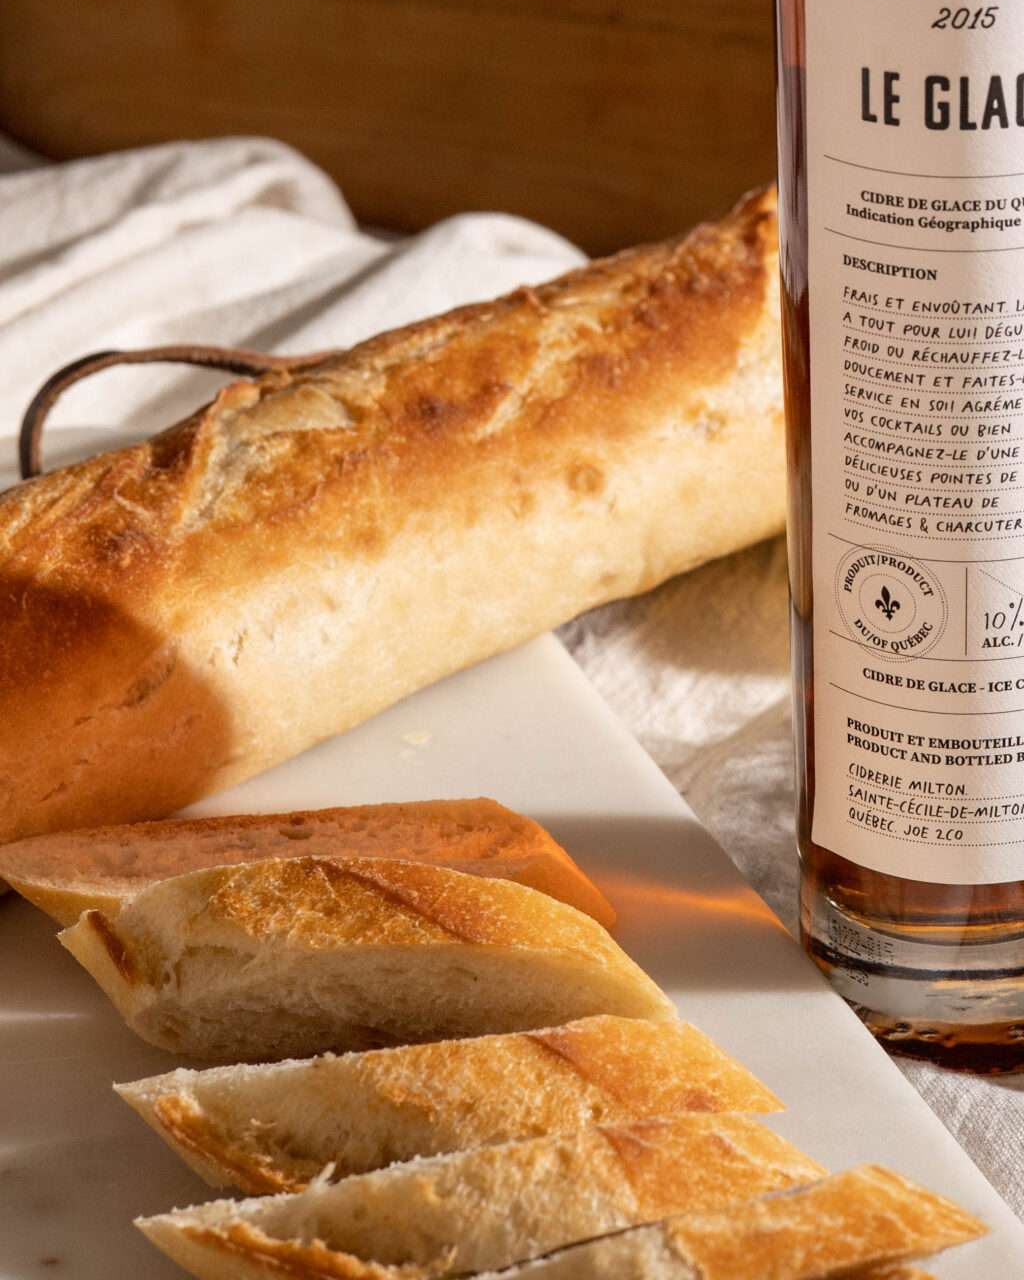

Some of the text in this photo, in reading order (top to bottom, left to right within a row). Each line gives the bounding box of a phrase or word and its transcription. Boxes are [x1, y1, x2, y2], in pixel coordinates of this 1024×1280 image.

[931, 6, 999, 29] 2015
[861, 67, 900, 127] LE
[861, 190, 904, 208] CIDRE
[908, 198, 927, 210] DE
[931, 200, 981, 212] GLACE
[986, 198, 1007, 211] DU
[846, 204, 914, 227] Indication
[918, 217, 1021, 232] Géographique
[843, 254, 938, 280] DESCRIPTION
[843, 286, 879, 306] FRAIS
[885, 297, 904, 310] ET
[842, 311, 852, 323] A
[859, 315, 896, 333] TOUT
[903, 324, 940, 339] POUR
[844, 336, 880, 353] FROID
[887, 345, 904, 359] OU
[844, 360, 926, 386] DOUCEMENT
[933, 376, 954, 387] ET
[844, 383, 894, 405] SERVICE
[901, 397, 920, 409] EN
[844, 408, 1011, 437] VOS COCKTAILS OU BIEN
[843, 432, 968, 461] ACCOMPAGNEZ-LE
[977, 446, 1020, 461] D'UNE
[845, 455, 922, 482] DÉLICIEUSES
[930, 472, 992, 485] POINTES
[1000, 471, 1018, 484] DE
[845, 478, 1000, 509] OU D'UN PLATEAU DE
[845, 502, 912, 529] FROMAGES
[920, 517, 928, 533] &
[890, 621, 934, 653] QUÉBEC
[863, 668, 903, 687] CIDRE
[907, 678, 925, 690] DE
[928, 681, 976, 694] GLACE
[988, 680, 1012, 692] ICE
[847, 717, 904, 743] PRODUIT
[907, 735, 925, 747] ET
[847, 733, 907, 760] PRODUCT
[910, 751, 941, 765] AND
[945, 754, 1013, 766] BOTTLED
[849, 762, 903, 789] CIDRERIE
